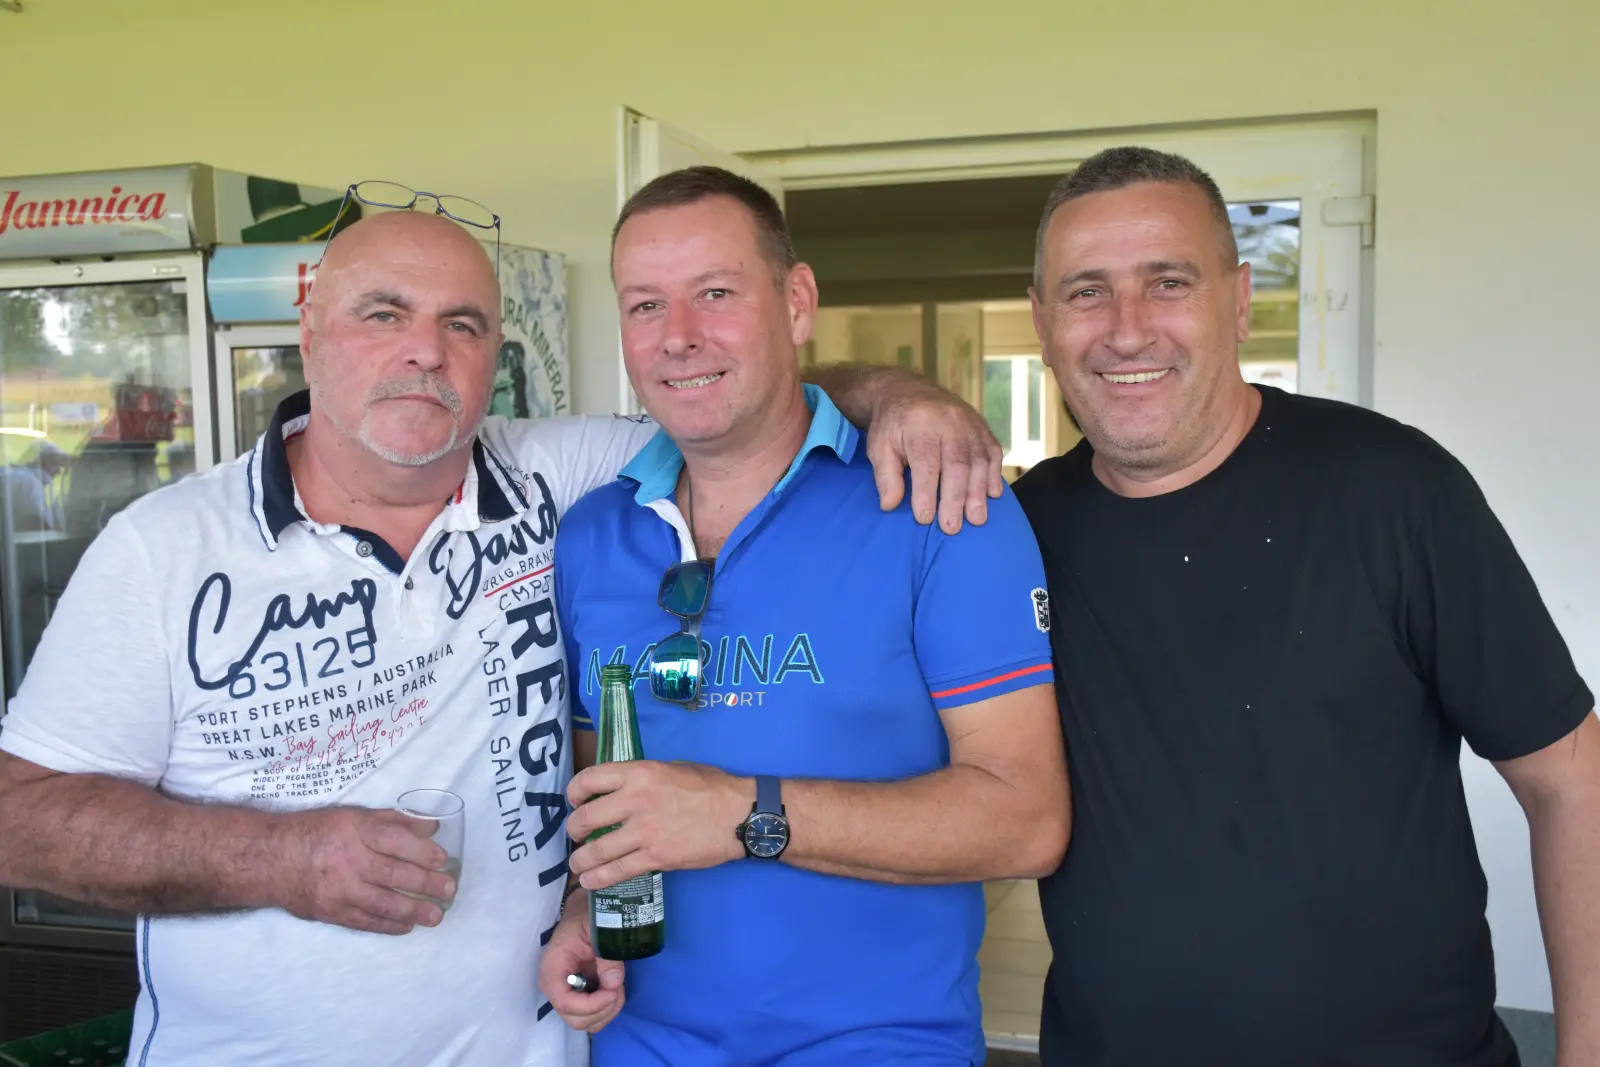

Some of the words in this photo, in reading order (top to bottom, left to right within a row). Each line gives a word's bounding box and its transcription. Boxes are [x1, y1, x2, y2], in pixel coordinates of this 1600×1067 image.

[0, 186, 167, 236] Jamnica
[530, 321, 567, 416] MINERAL
[187, 571, 378, 691] Camp
[478, 619, 512, 717] LASER
[197, 710, 238, 726] PORT
[248, 684, 348, 721] STEPHENS
[373, 643, 454, 686] AUSTRALIA
[202, 728, 251, 745] GREAT
[260, 713, 321, 740] LAKES
[329, 689, 395, 723] MARINE
[402, 670, 438, 697] PARK
[282, 735, 318, 756] Bay
[327, 711, 385, 750] Sailing
[390, 697, 429, 723] Centre
[286, 771, 329, 781] REGARDED
[286, 789, 319, 797] TRACKS
[313, 778, 334, 787] BEST
[490, 736, 528, 862] SAILING
